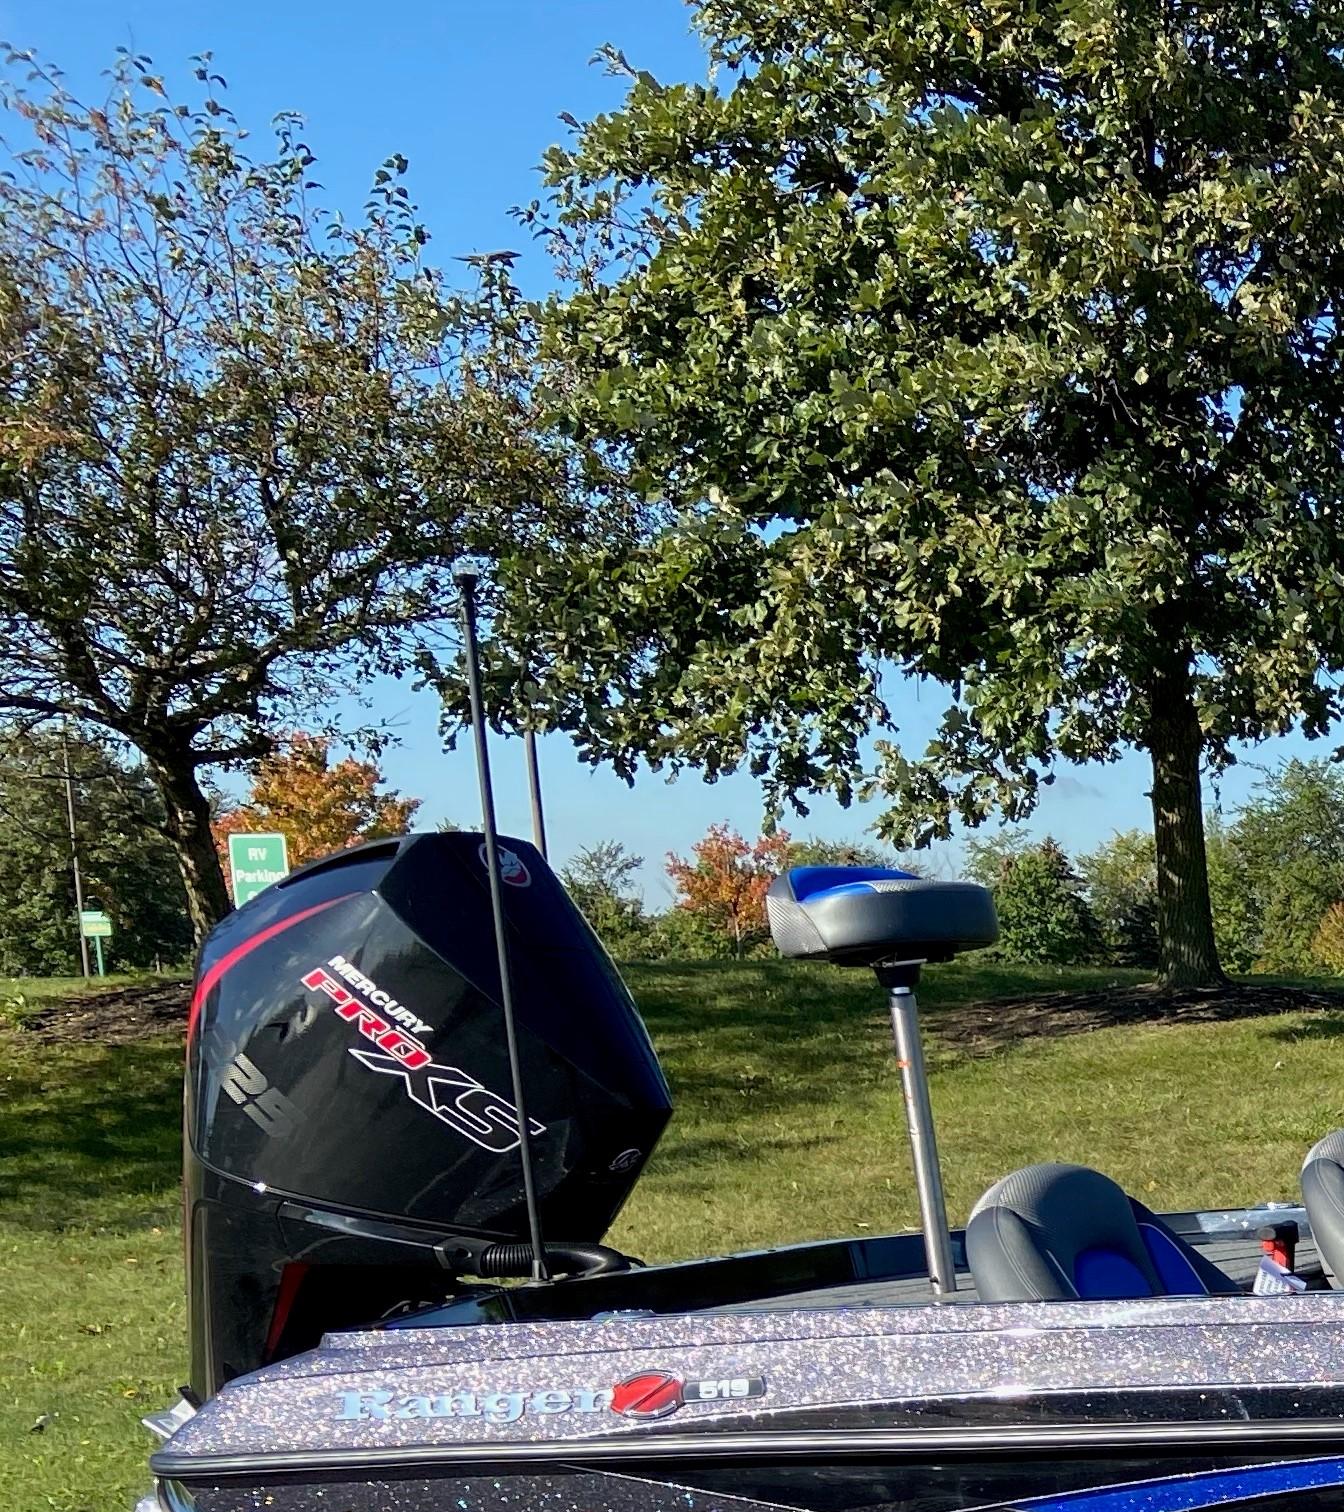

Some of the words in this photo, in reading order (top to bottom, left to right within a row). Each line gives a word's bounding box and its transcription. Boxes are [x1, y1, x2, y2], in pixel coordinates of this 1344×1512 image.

[247, 847, 267, 861] RV
[301, 967, 432, 1071] PRO
[327, 955, 434, 1035] MERCURY
[348, 1048, 547, 1153] XS
[334, 1388, 613, 1424] Ranger
[698, 1378, 750, 1399] 519
